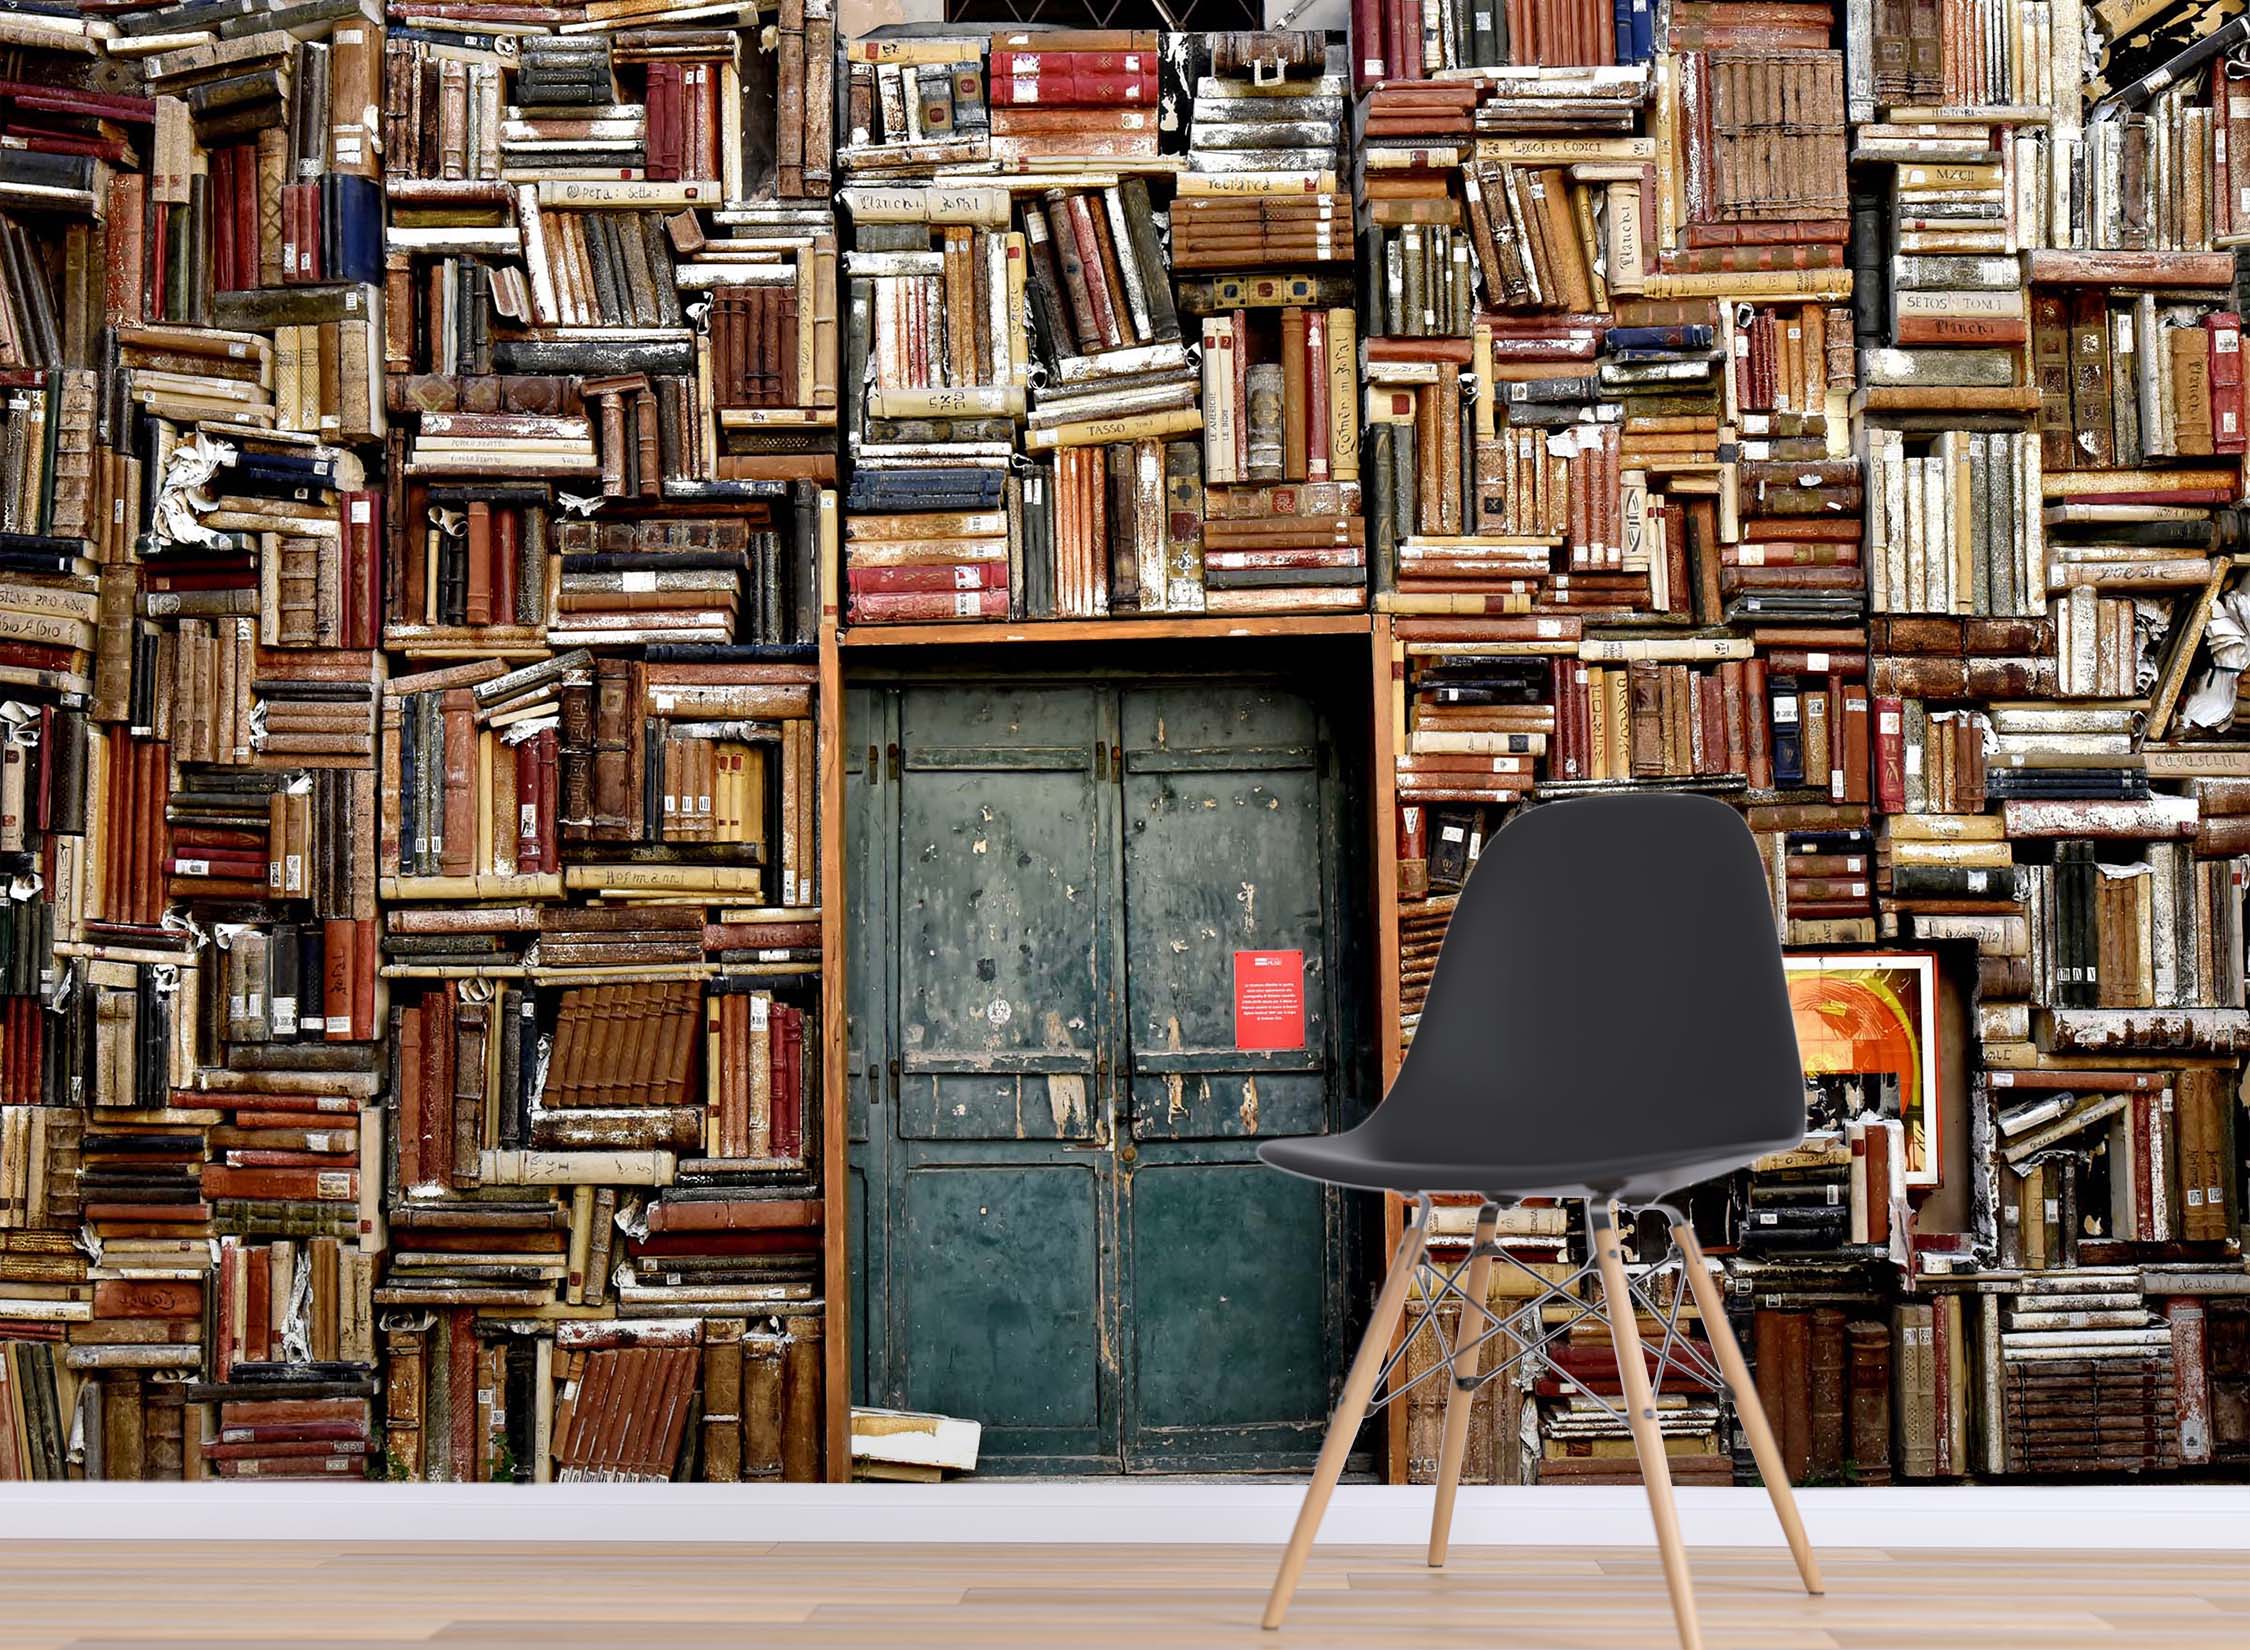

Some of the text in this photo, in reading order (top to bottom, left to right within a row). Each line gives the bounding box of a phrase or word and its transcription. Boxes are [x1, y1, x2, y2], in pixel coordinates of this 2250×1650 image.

[1513, 141, 1546, 154] LEGGI
[1563, 140, 1602, 153] CODICI
[1906, 296, 1948, 310] SETOS
[1086, 423, 1126, 437] TASSO
[35, 595, 58, 608] PRO
